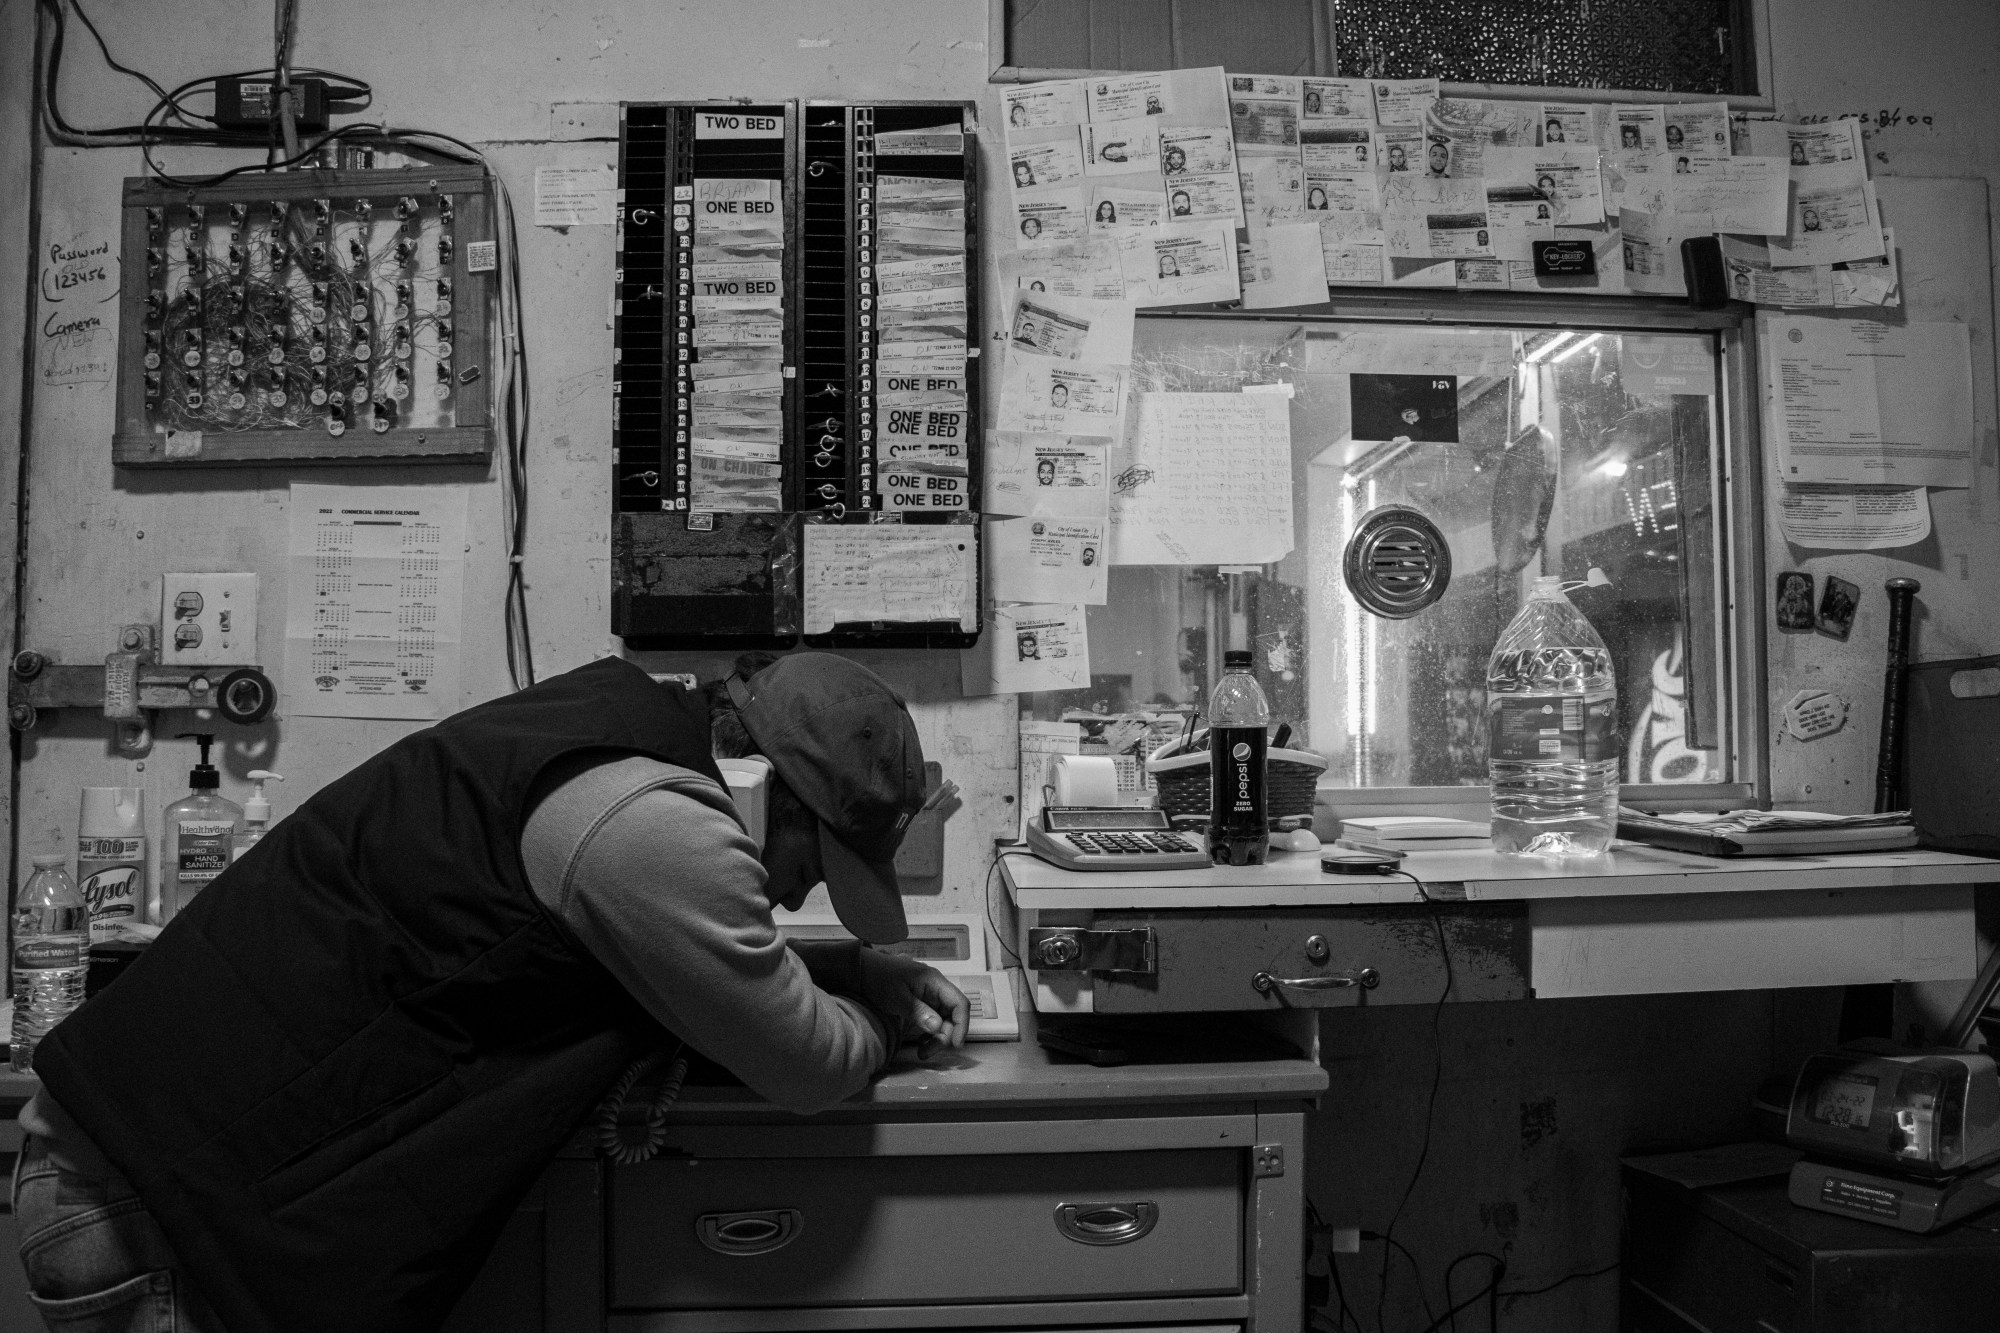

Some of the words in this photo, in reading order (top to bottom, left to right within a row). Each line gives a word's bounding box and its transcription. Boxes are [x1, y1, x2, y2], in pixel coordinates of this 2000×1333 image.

[705, 117, 739, 129] TWO
[746, 118, 776, 130] BED
[706, 201, 738, 213] ONE
[744, 202, 774, 213] BED
[50, 242, 107, 263] Password
[863, 253, 868, 261] 5
[55, 267, 106, 290] 123456
[704, 283, 738, 295] TWO
[746, 282, 776, 294] BED
[44, 312, 101, 338] Camera
[888, 379, 919, 390] ONE
[927, 380, 957, 390] BED
[890, 411, 922, 423] ONE
[929, 412, 960, 425] BED
[888, 422, 920, 435] ONE
[927, 424, 957, 437] BED
[725, 461, 772, 477] CHANGE
[888, 475, 920, 488] ONE
[927, 477, 957, 491] BED
[677, 499, 686, 508] 41
[893, 494, 925, 506] ONE
[932, 494, 963, 506] BED
[1236, 762, 1250, 799] pepsi
[93, 839, 125, 855] 100
[80, 870, 136, 914] Lysol
[19, 950, 49, 958] Purified
[50, 949, 76, 957] Water
[1841, 1182, 1853, 1190] Time
[1853, 1185, 1881, 1195] Equipment
[1881, 1191, 1896, 1199] Corp.
